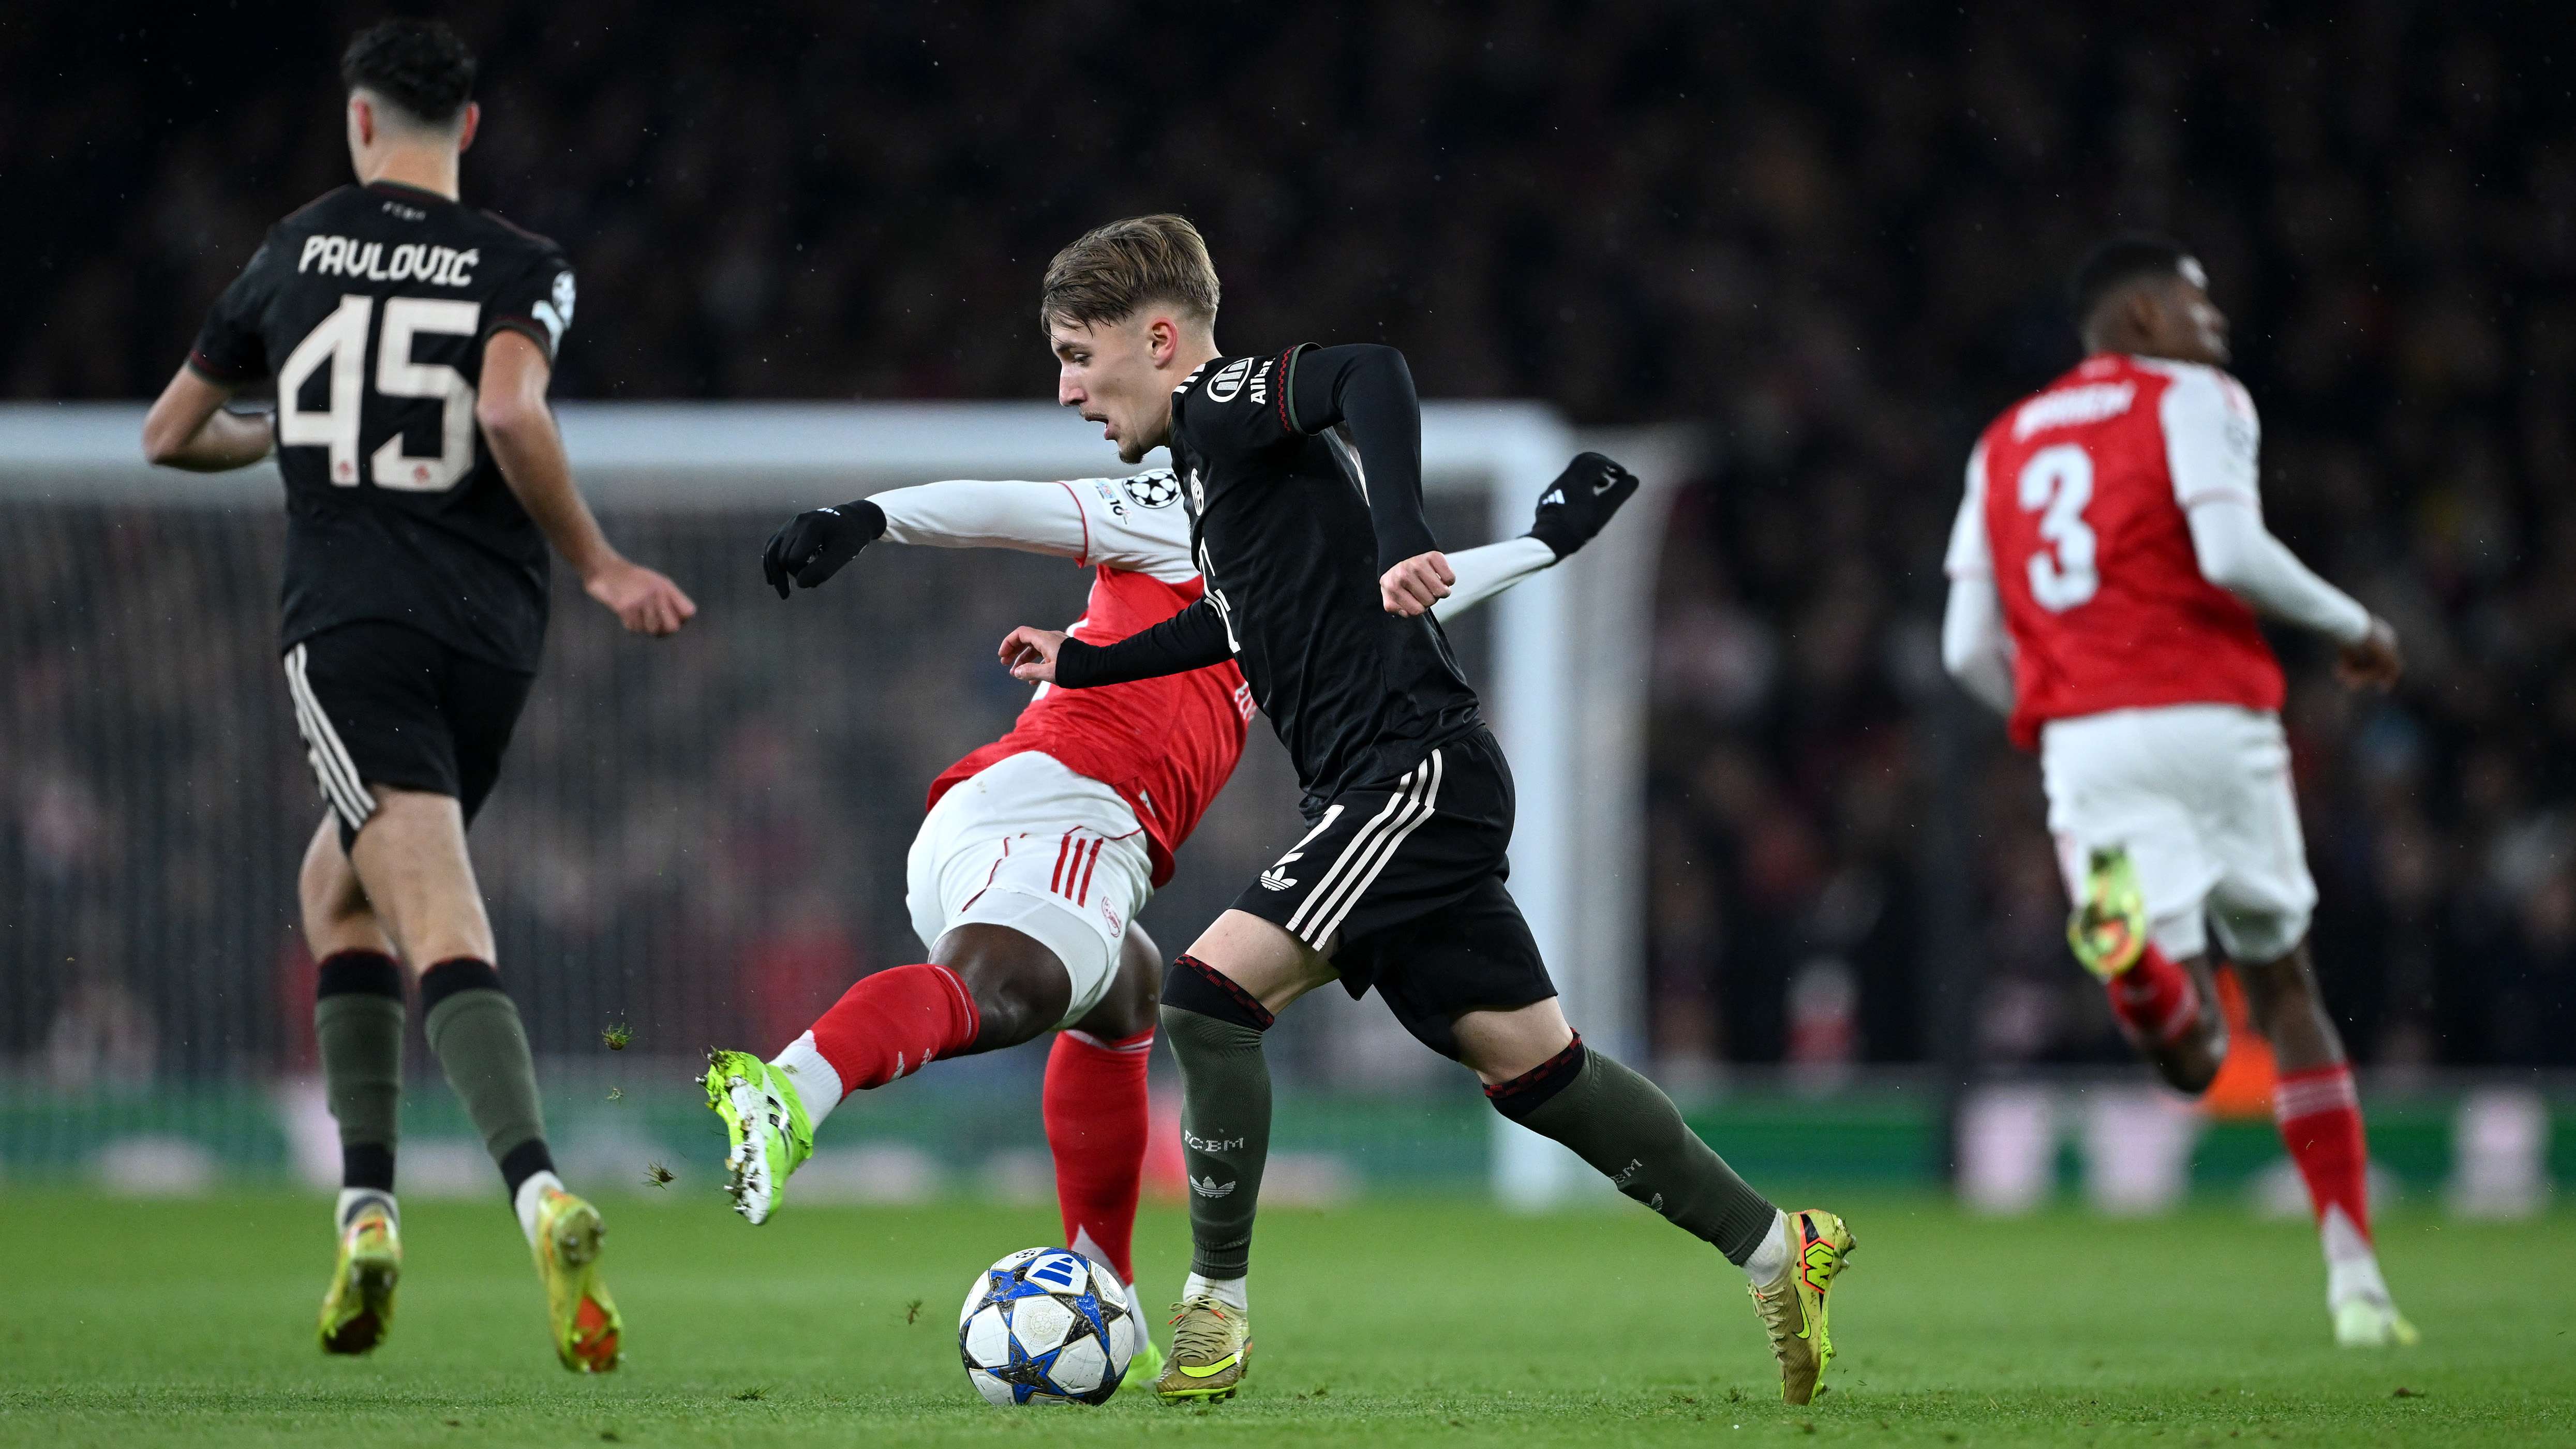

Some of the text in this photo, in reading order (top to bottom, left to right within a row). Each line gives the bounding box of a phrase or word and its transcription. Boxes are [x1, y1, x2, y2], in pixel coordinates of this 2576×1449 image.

[277, 294, 481, 492] 45
[1250, 357, 1276, 405] Allia
[2018, 444, 2100, 614] 3
